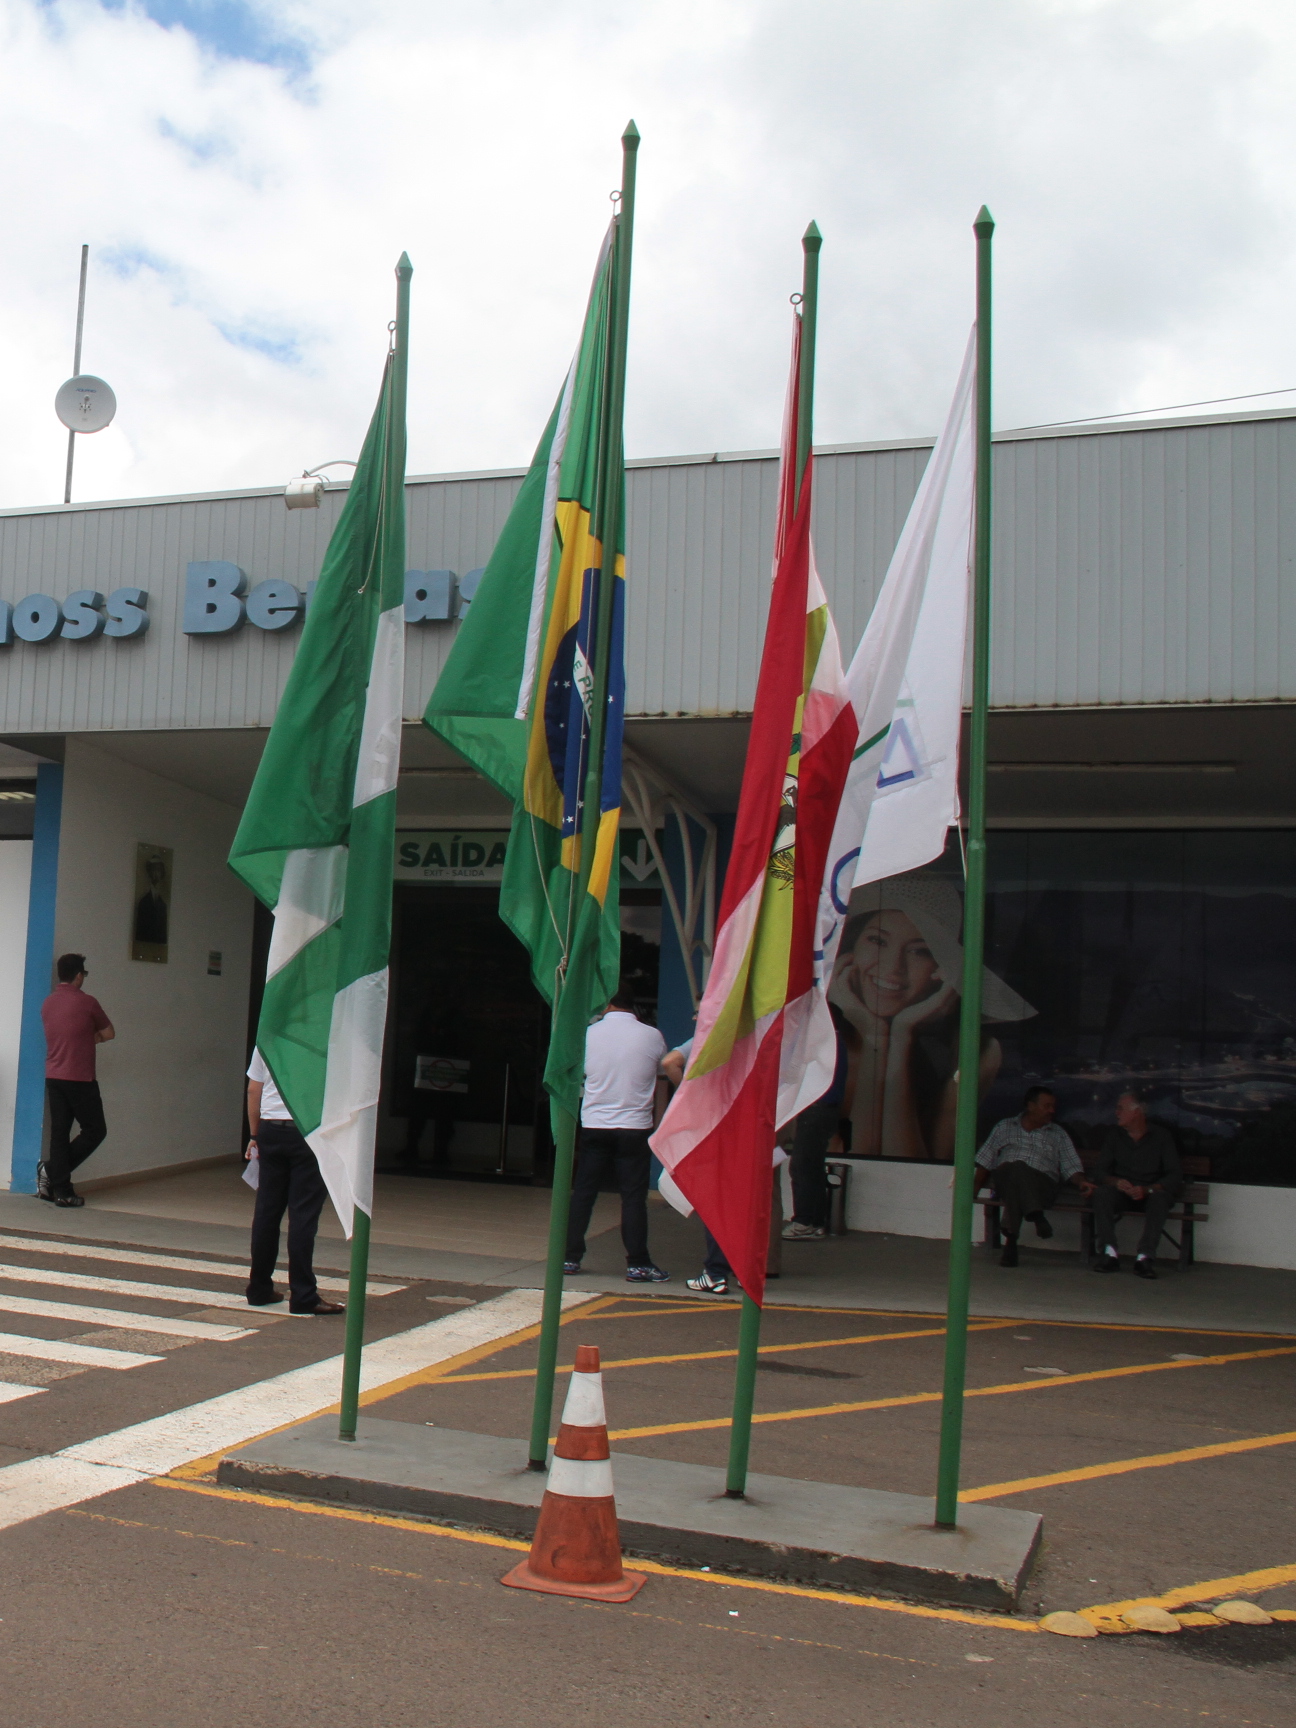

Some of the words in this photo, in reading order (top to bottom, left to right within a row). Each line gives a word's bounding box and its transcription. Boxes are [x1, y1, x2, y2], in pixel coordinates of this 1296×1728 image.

[398, 835, 505, 868] SAÍDA
[423, 869, 443, 877] EXIT
[452, 869, 485, 877] SALIDA
